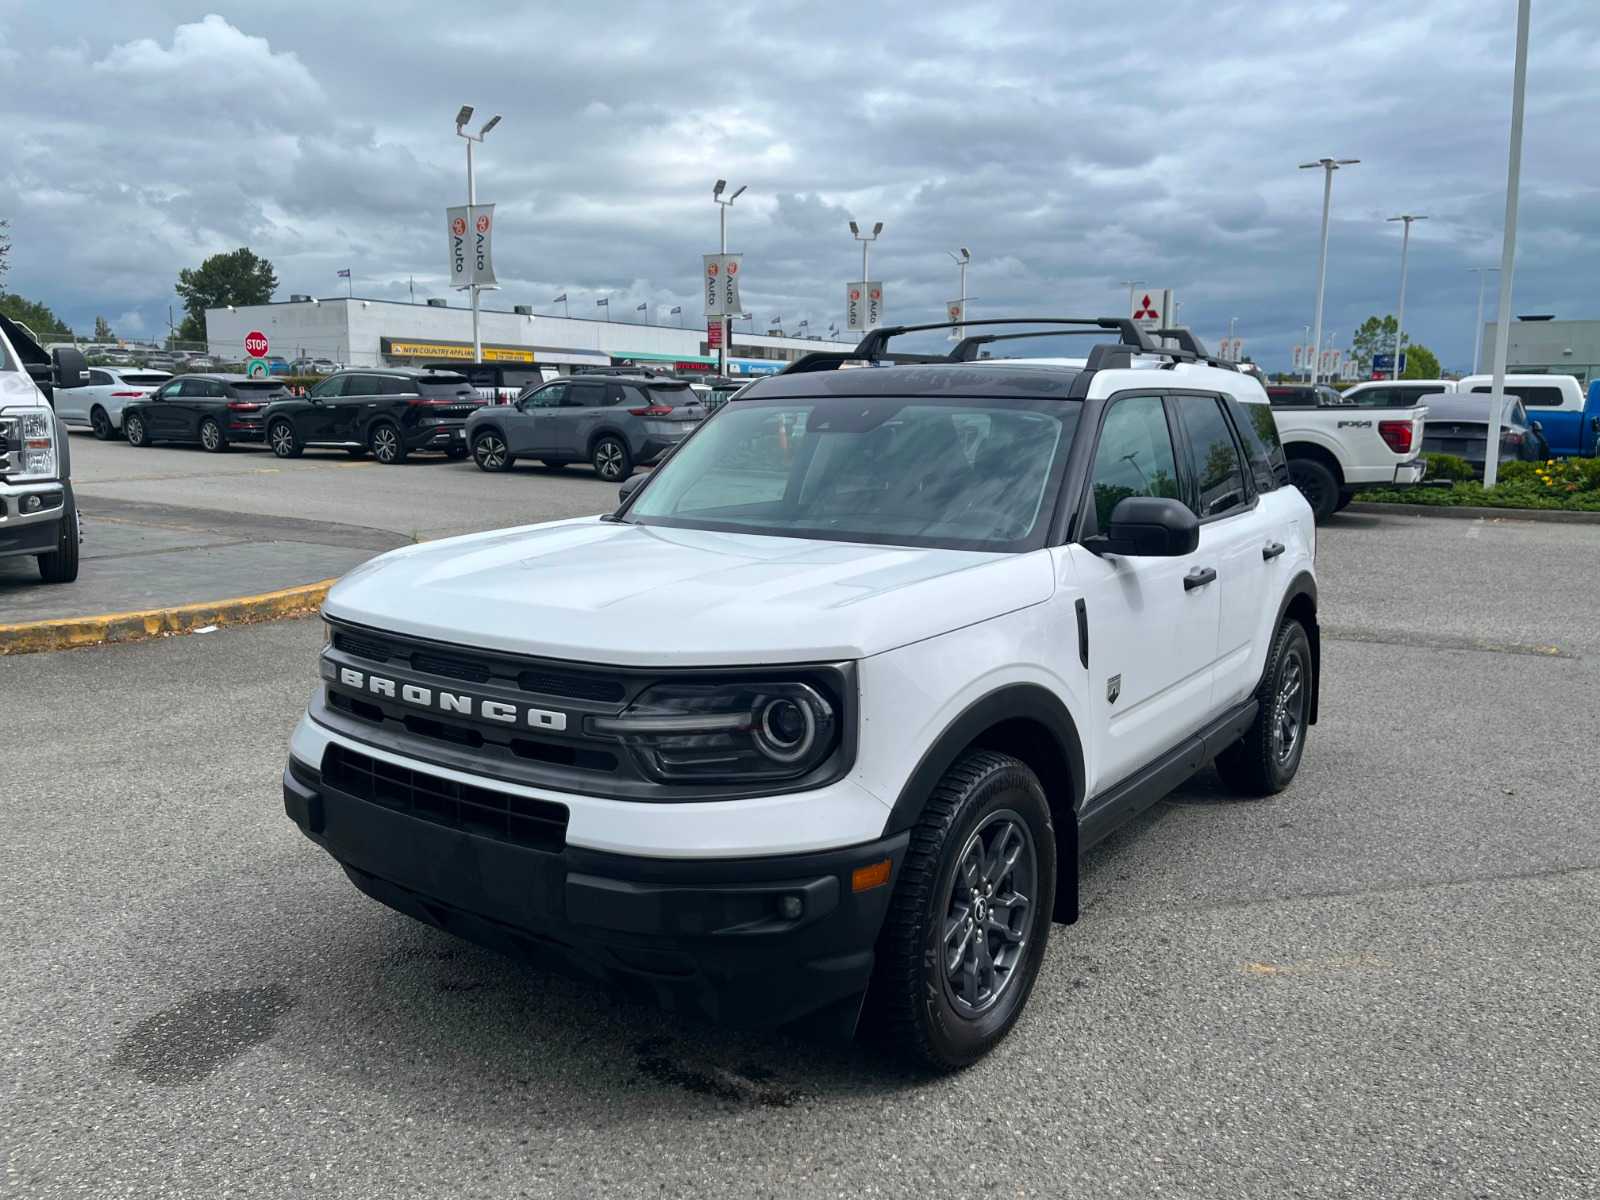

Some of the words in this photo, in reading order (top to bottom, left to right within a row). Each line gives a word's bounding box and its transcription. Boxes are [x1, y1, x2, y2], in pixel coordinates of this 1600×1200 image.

[454, 236, 464, 273] Auto
[476, 233, 485, 271] Auto
[708, 277, 716, 306] Auto
[726, 275, 734, 304] Auto
[246, 338, 267, 350] STOP
[340, 667, 567, 731] BRONCO
